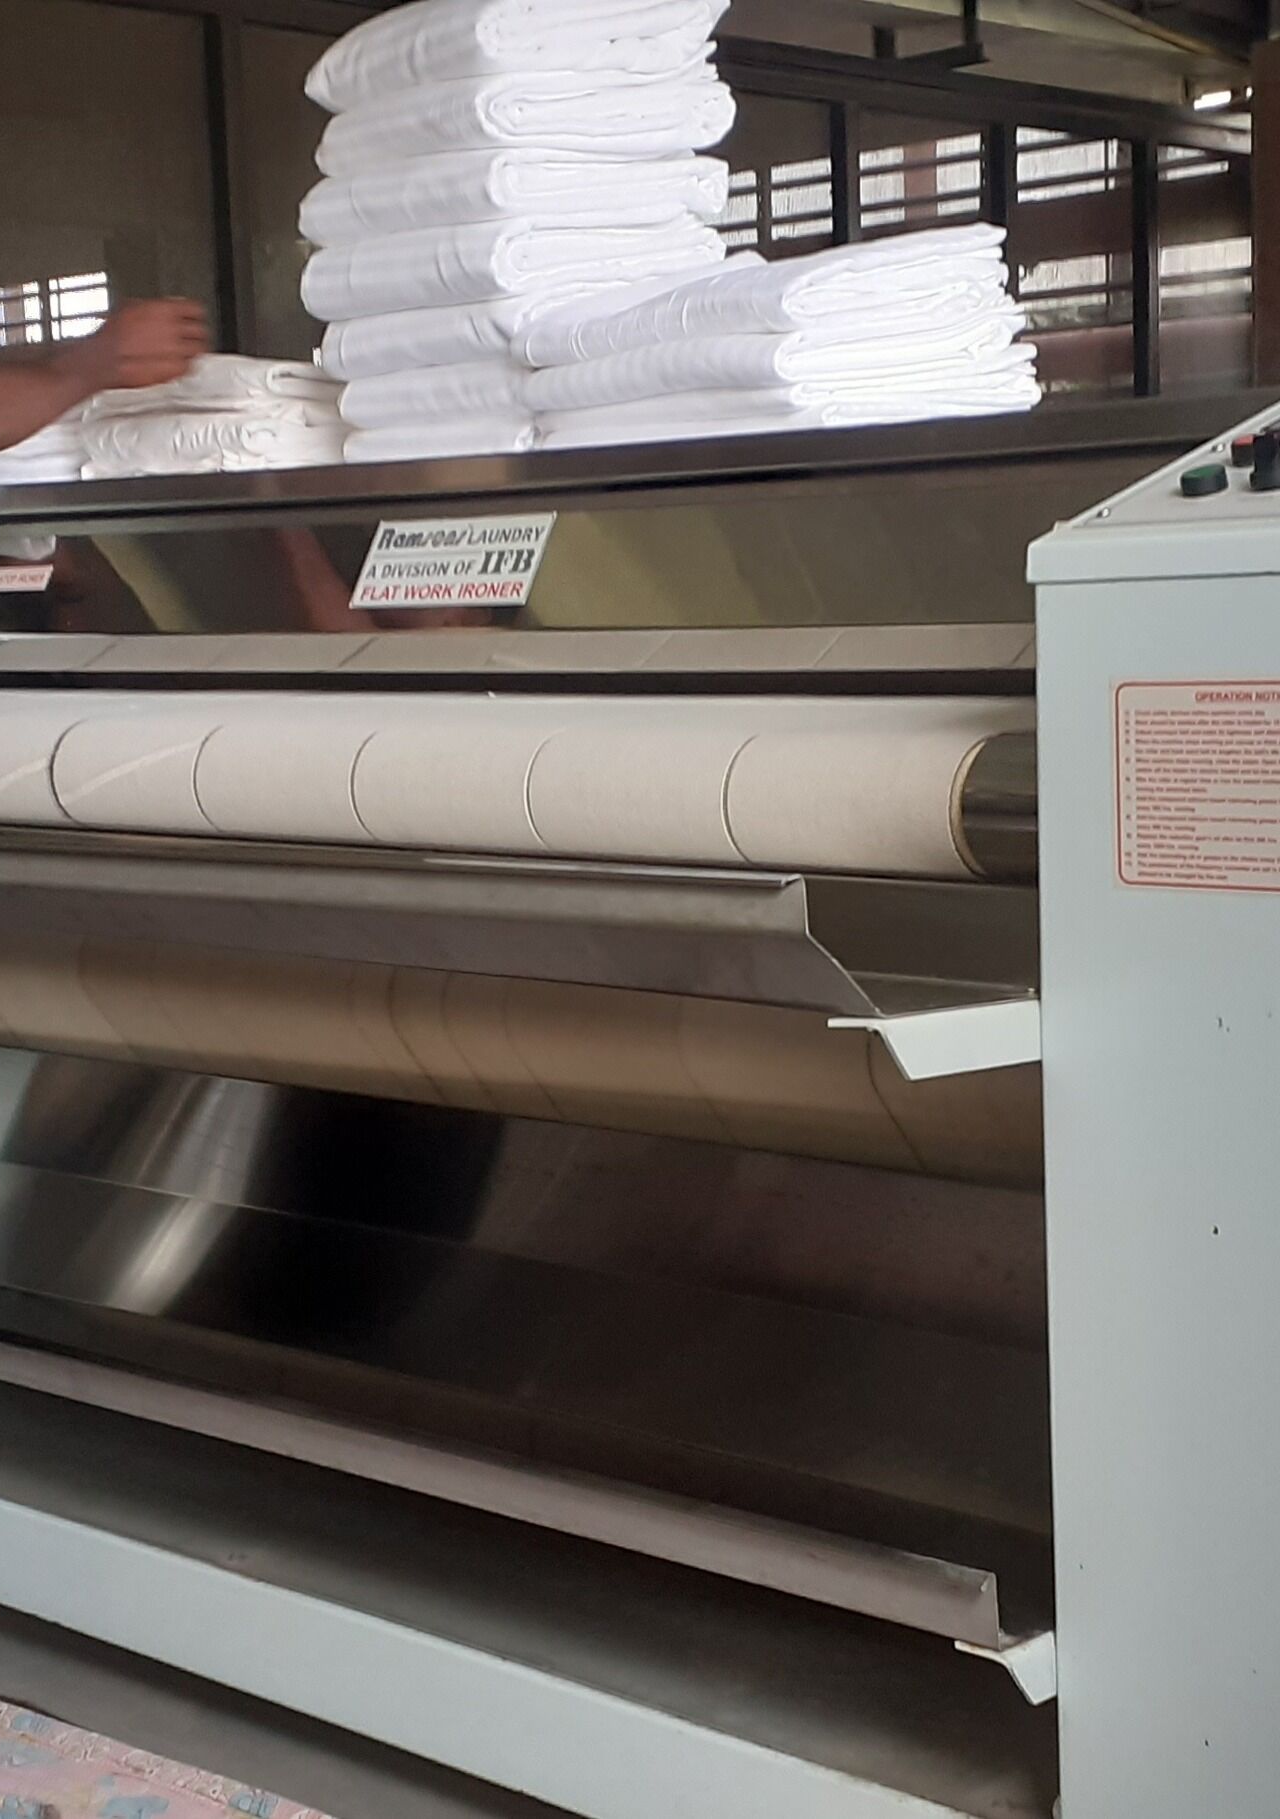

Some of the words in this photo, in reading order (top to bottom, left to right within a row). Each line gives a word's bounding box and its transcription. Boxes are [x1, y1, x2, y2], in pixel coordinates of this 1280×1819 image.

[468, 526, 545, 545] LAUNDRY
[366, 564, 376, 579] A
[380, 560, 451, 578] DIVISION
[454, 559, 477, 576] OF
[477, 548, 536, 576] IFB
[360, 583, 401, 600] FLAT
[403, 582, 455, 600] WORK
[458, 580, 524, 598] IRONER
[1195, 691, 1253, 703] OPERATION
